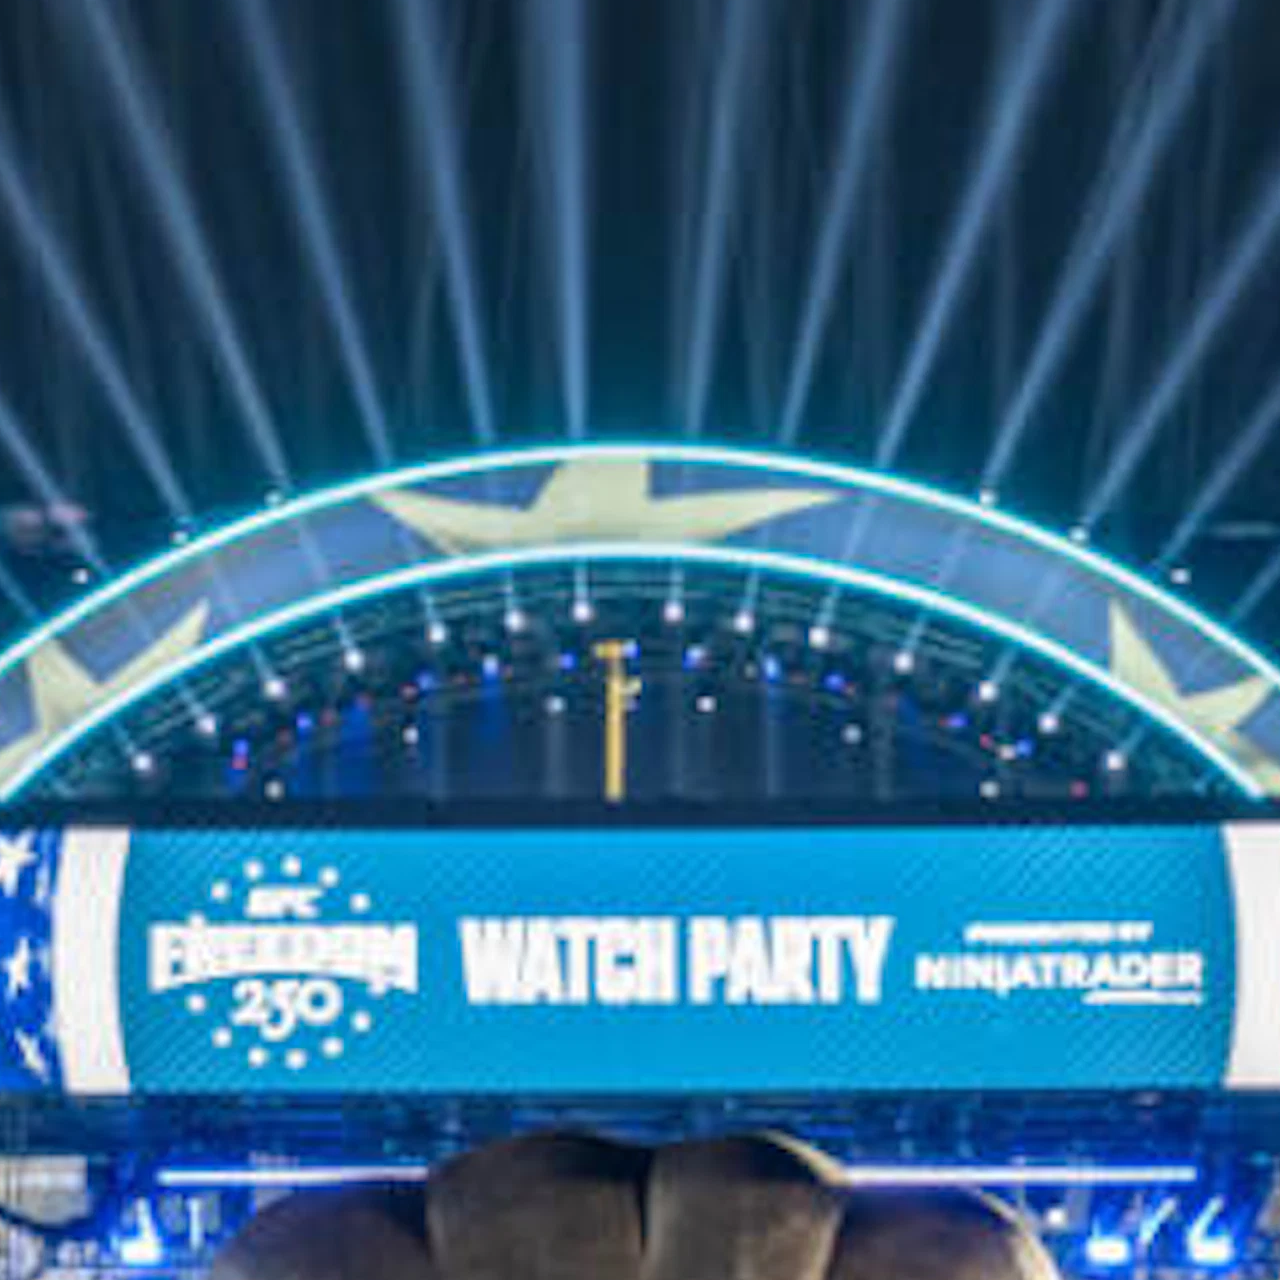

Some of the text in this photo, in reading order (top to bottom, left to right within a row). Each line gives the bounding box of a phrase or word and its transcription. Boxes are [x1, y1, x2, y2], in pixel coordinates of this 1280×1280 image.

[460, 917, 894, 1004] WATCH PARTY
[914, 952, 1202, 998] NINJATRADER
[232, 979, 342, 1040] 250
